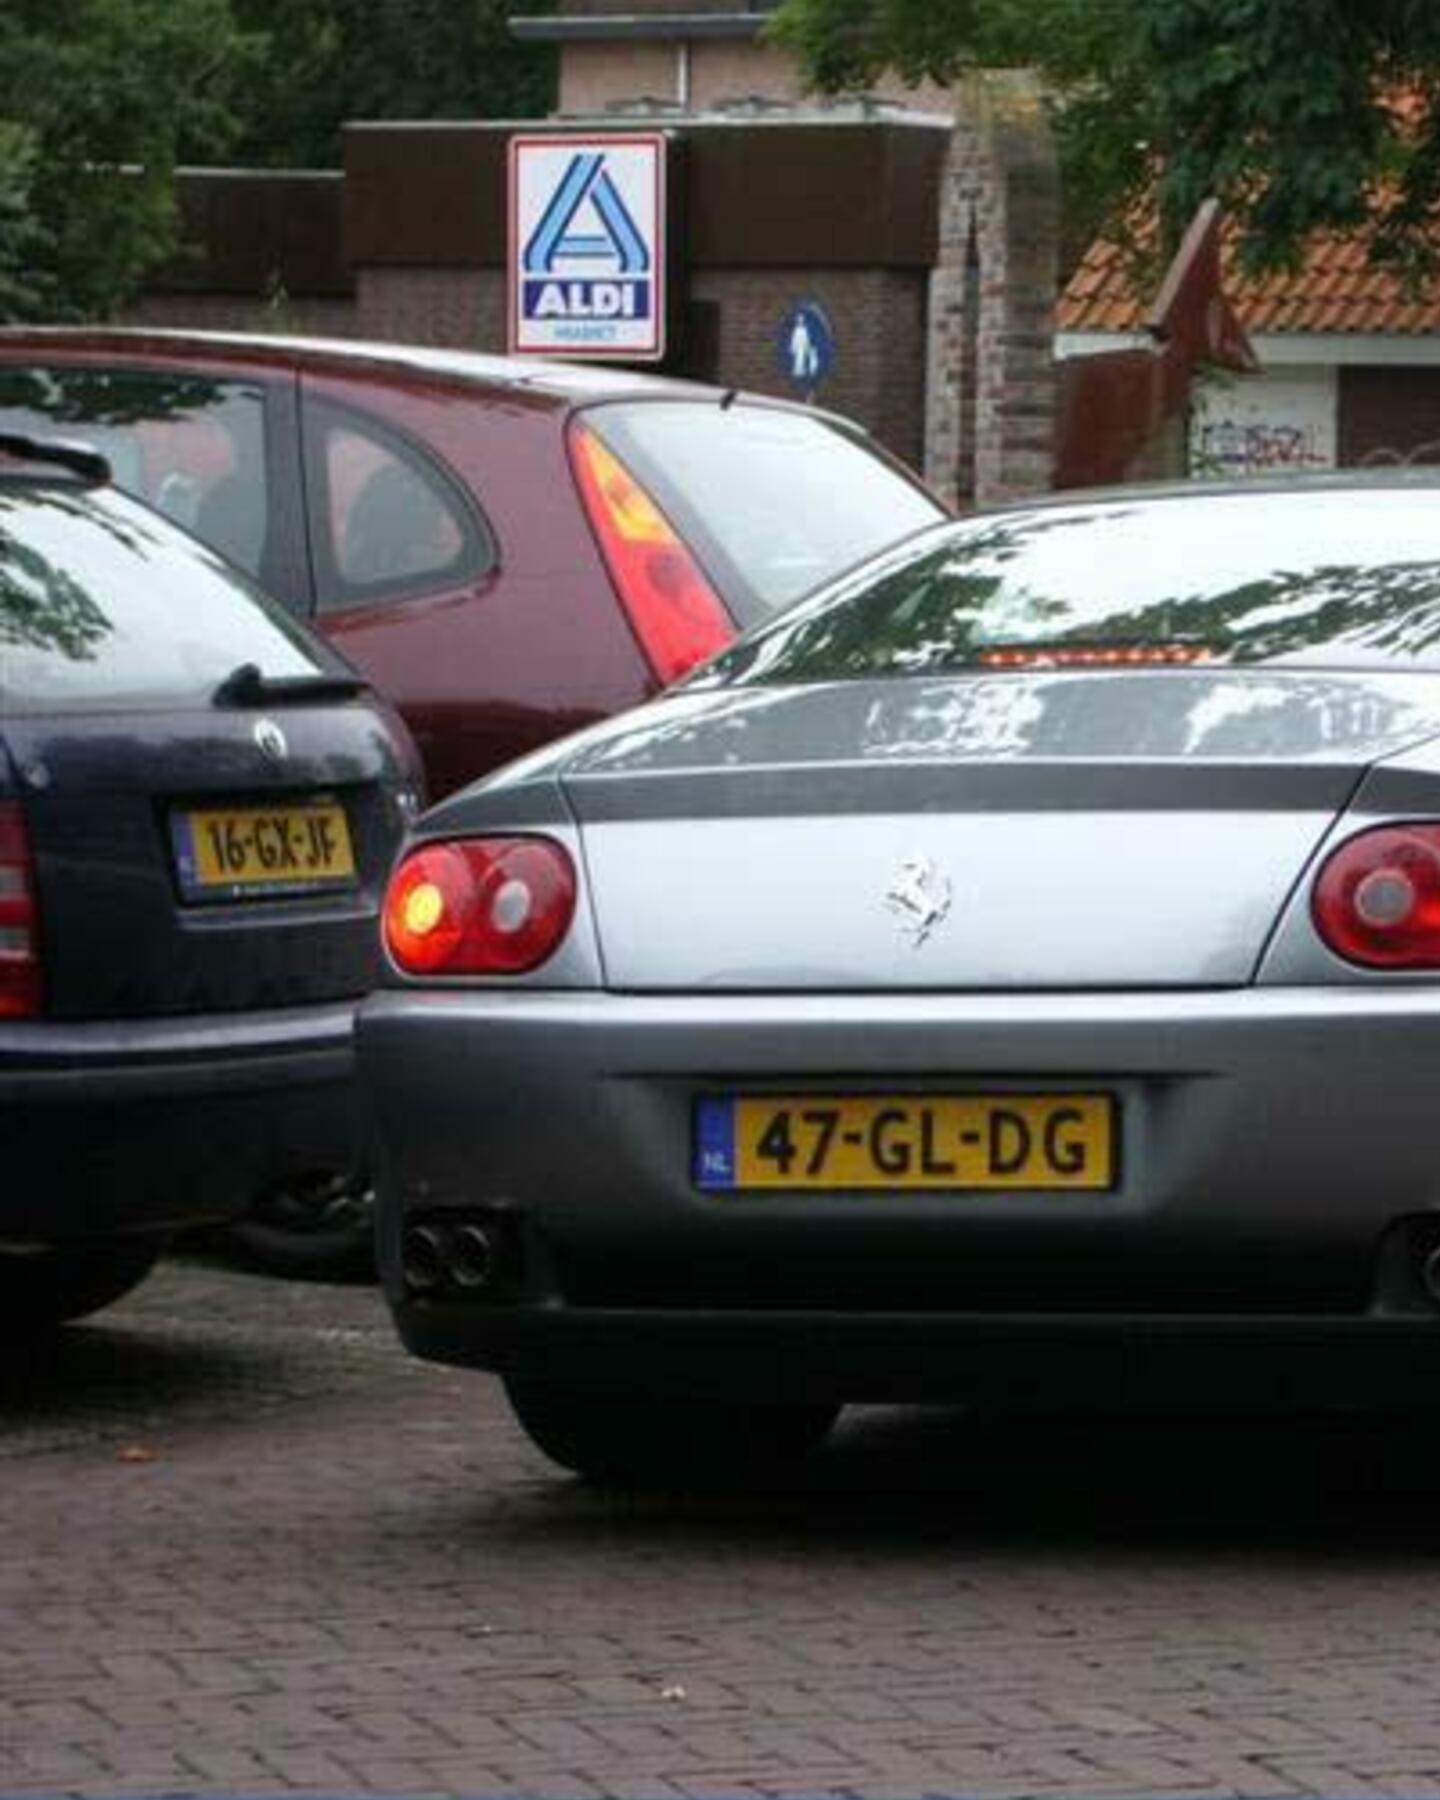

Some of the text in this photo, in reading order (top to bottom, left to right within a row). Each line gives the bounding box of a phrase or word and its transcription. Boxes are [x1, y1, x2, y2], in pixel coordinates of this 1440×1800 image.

[535, 284, 635, 315] ALDI
[207, 816, 335, 874] 16-GX-JF
[703, 1108, 1085, 1175] NL 47-GL-DG
